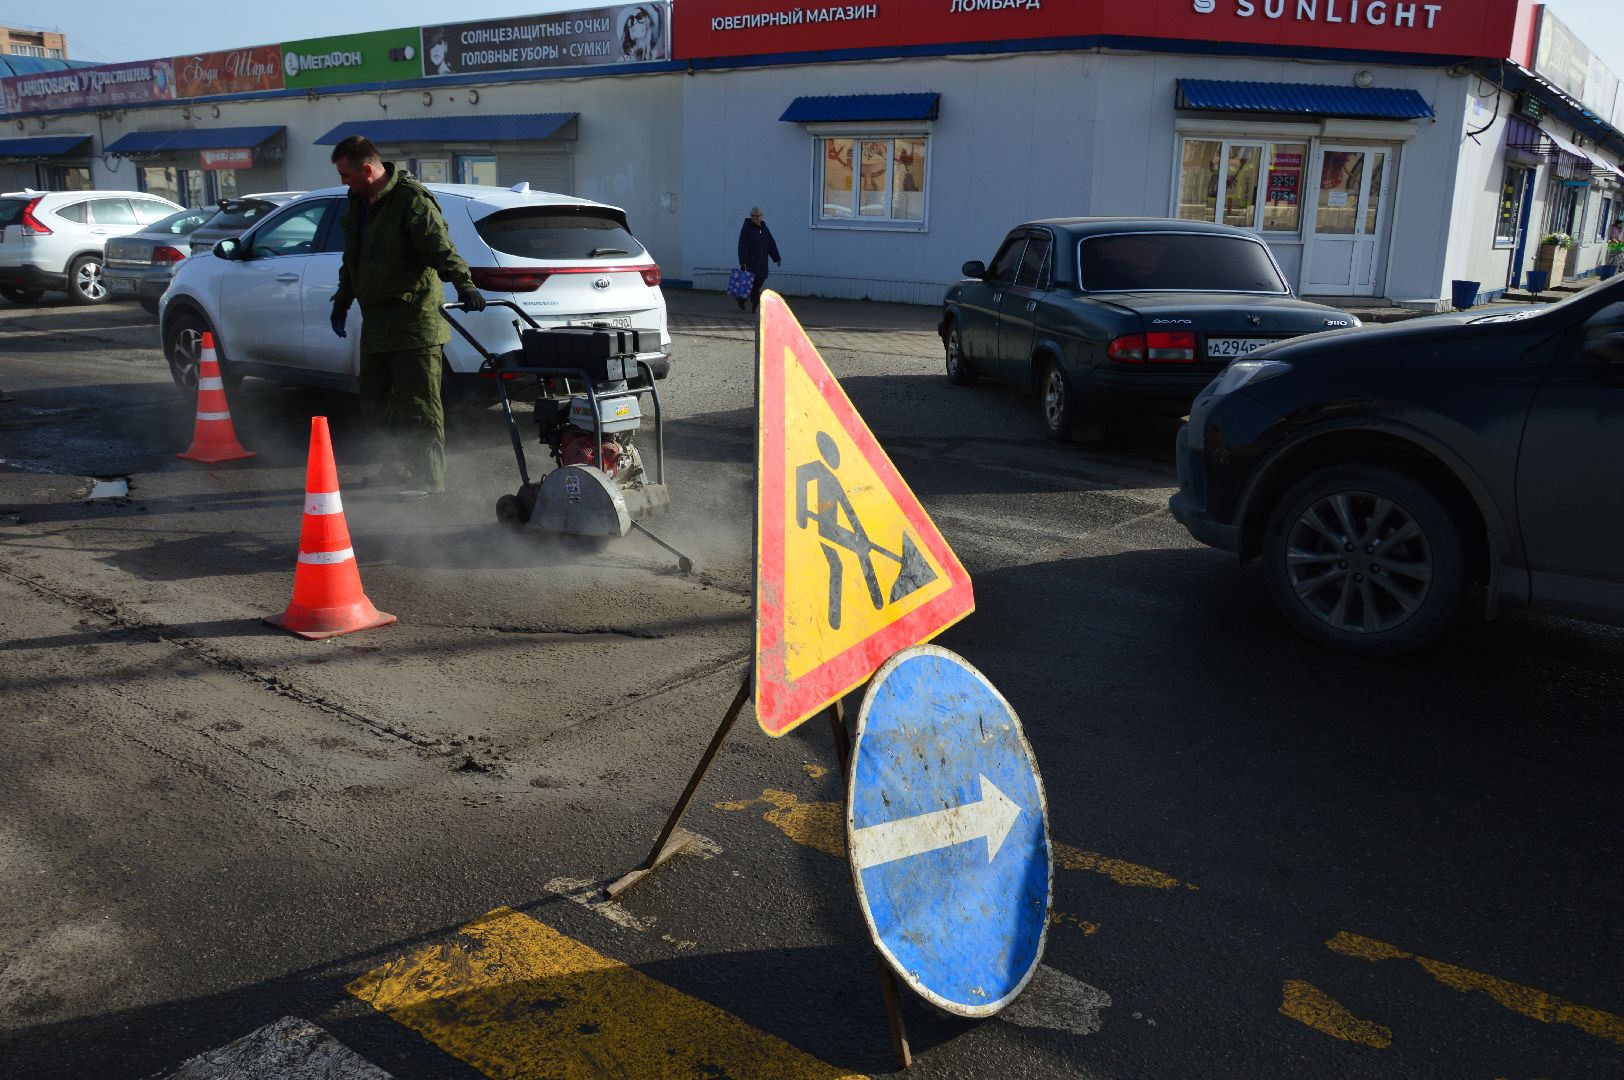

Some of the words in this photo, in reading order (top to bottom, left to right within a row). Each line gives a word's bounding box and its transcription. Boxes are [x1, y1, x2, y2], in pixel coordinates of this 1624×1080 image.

[711, 8, 803, 31] ЮВЕЛИРНЫЙ
[806, 4, 877, 23] МАГАЗИН
[950, 0, 1040, 13] ЛОМБАРД
[1237, 0, 1441, 29] SUNLIGHT
[461, 20, 571, 45] СОЛНЦЕЗАЩИТНЫЕ
[574, 18, 610, 34] ОЧКИ
[461, 48, 518, 66] ГОЛОВНЫЕ
[520, 44, 559, 61] УБОРЫ
[569, 41, 610, 57] СУМКИ
[16, 75, 80, 98] КАНЦТОВАРЫ
